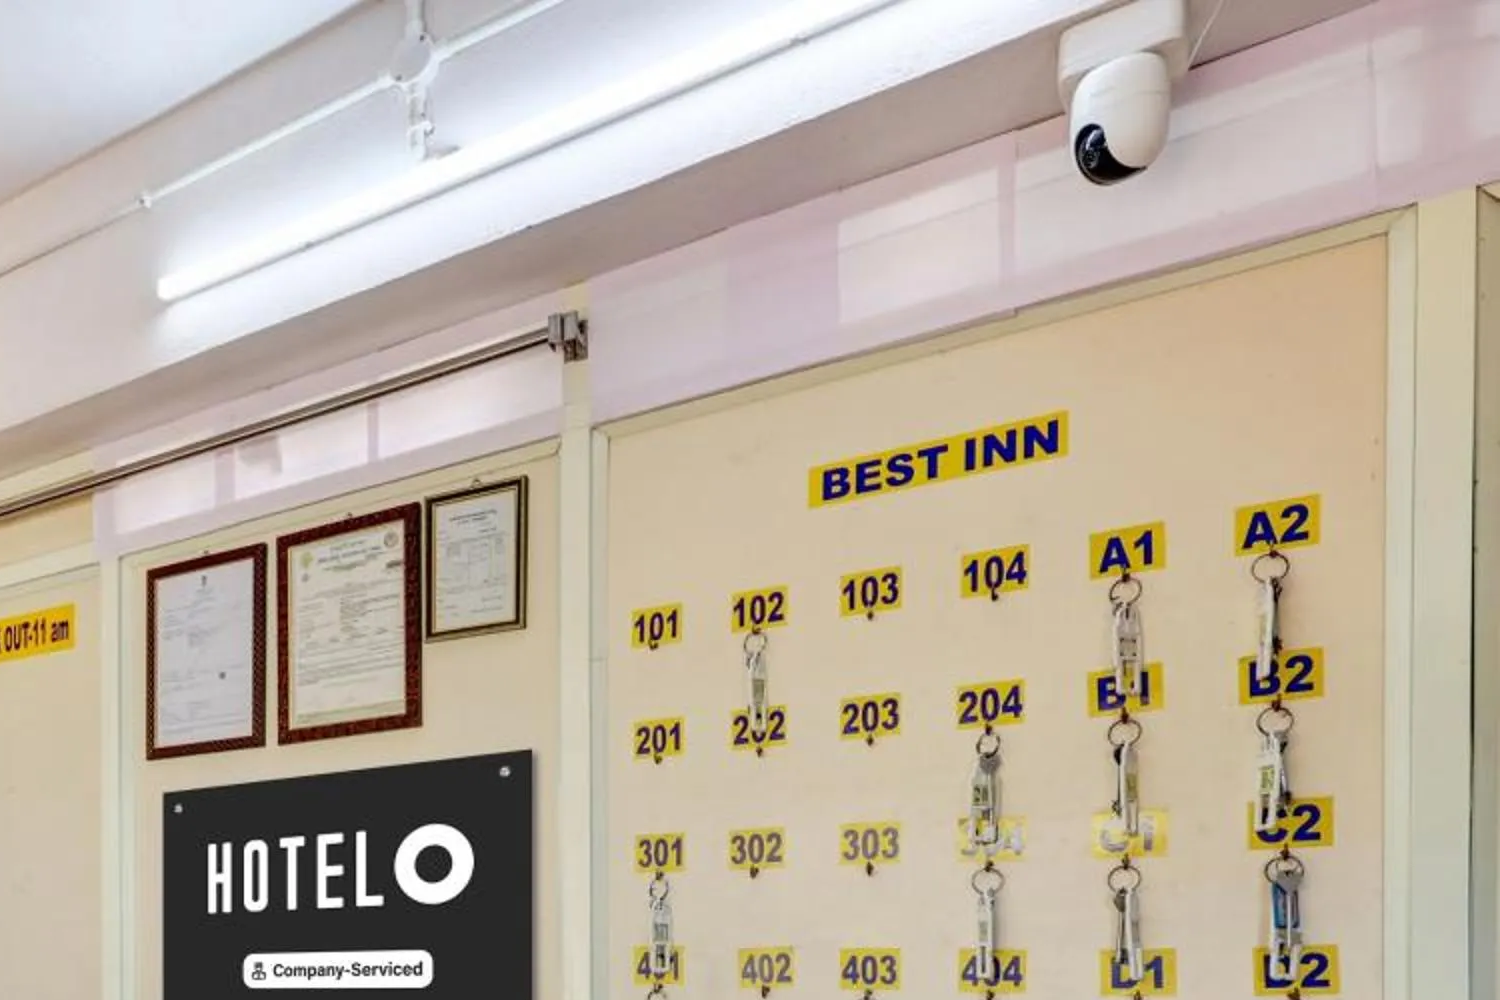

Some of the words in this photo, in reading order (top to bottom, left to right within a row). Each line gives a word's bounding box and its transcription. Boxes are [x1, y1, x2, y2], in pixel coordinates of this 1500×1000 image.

[822, 444, 948, 500] BEST
[964, 419, 1059, 471] INN
[1242, 504, 1309, 550] A2
[1098, 530, 1153, 574] A1
[963, 551, 1027, 592] 104
[733, 591, 785, 628] 102
[841, 573, 899, 610] 103
[4, 617, 46, 653] OUT-11
[51, 619, 69, 643] am
[634, 609, 678, 643] 101
[1248, 654, 1314, 698] B2
[842, 698, 899, 734] 203
[958, 685, 1022, 724] 204
[636, 721, 681, 754] 201
[638, 837, 682, 868] 301
[731, 832, 783, 865] 302
[843, 828, 899, 860] 303
[207, 830, 385, 914] HOTEL
[393, 823, 475, 905] O
[273, 961, 423, 981] Company-Serviced
[637, 951, 680, 981] 41
[741, 952, 792, 984] 402
[842, 955, 897, 985] 403
